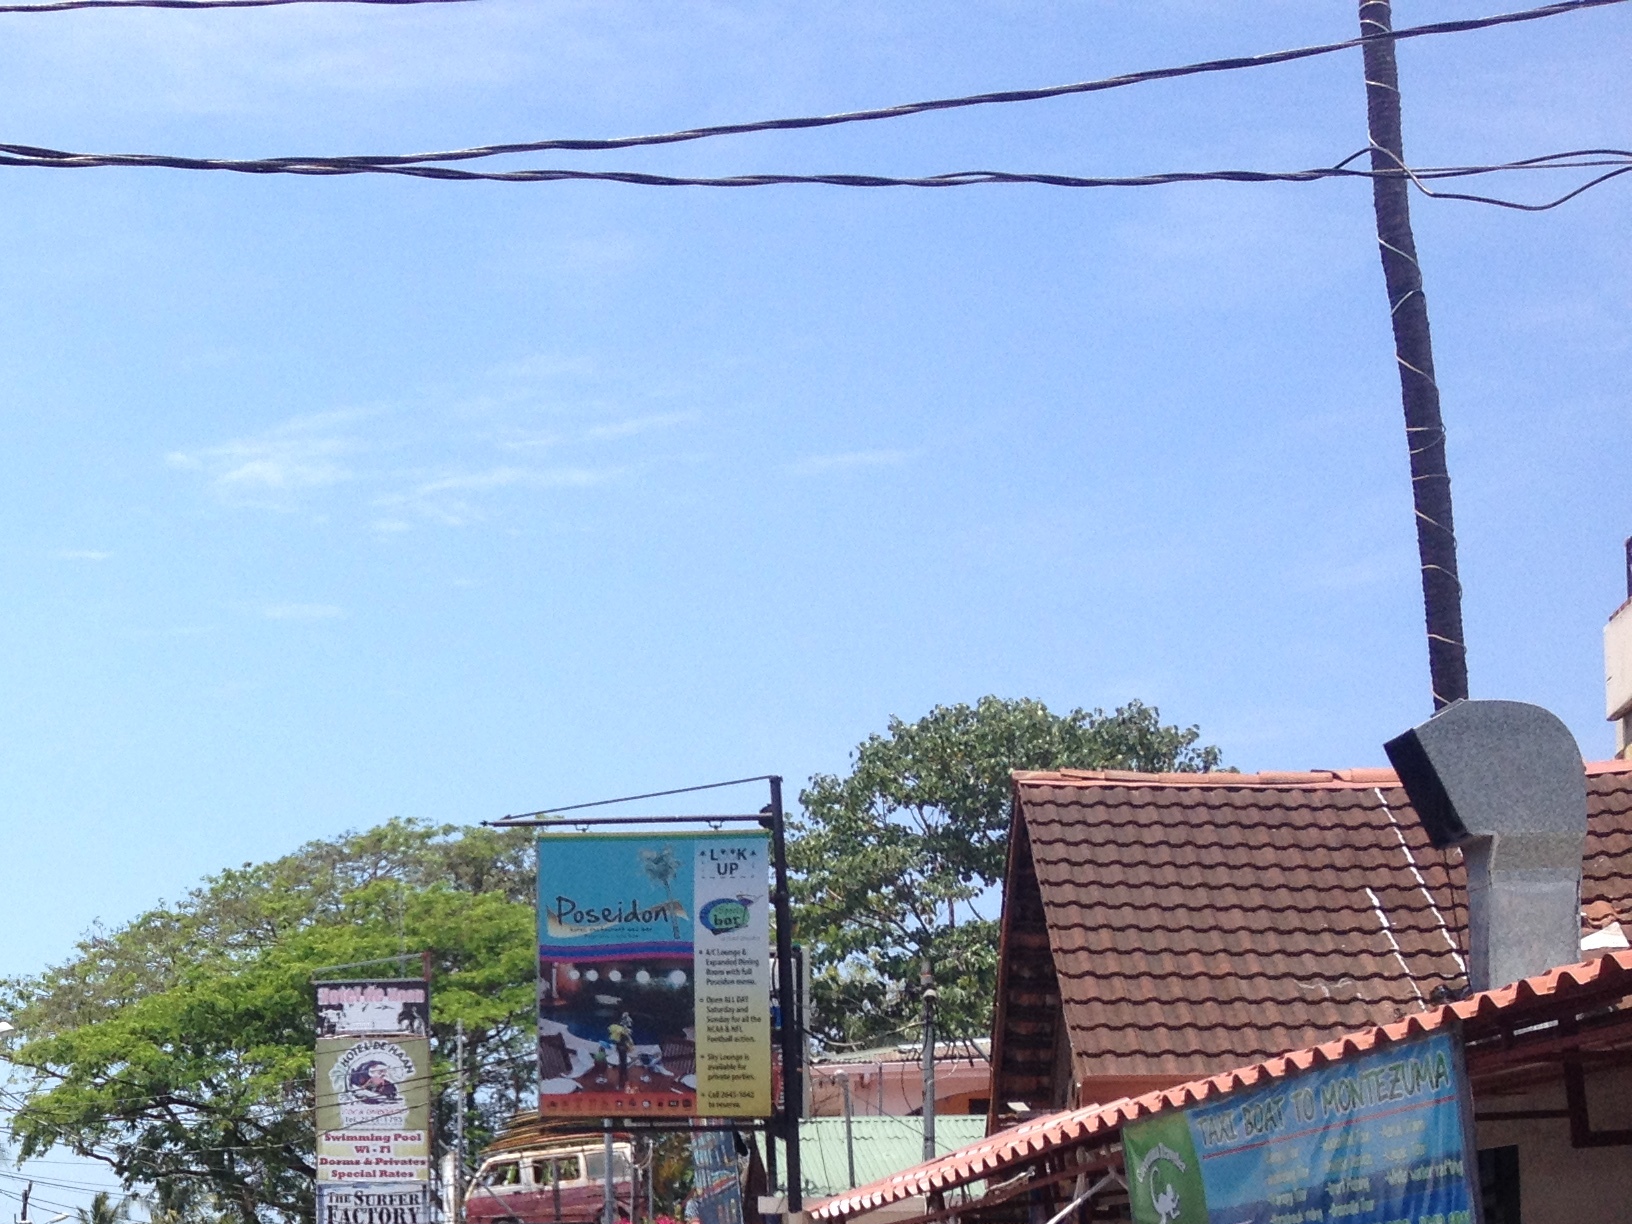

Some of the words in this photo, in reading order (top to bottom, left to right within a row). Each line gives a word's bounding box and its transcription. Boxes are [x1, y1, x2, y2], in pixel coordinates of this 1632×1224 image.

[717, 862, 739, 876] UP
[556, 896, 668, 926] Poseidon
[340, 1041, 371, 1068] HOTEL
[373, 1041, 388, 1051] DE
[1196, 1110, 1238, 1148] TAXI
[1241, 1096, 1285, 1137] BOAT
[1290, 1088, 1315, 1123] TO
[1320, 1050, 1451, 1118] MONTEZUMA
[324, 1133, 390, 1143] Swimming
[394, 1133, 422, 1142] Pool
[331, 1169, 376, 1179] Special
[379, 1169, 414, 1178] Rates
[354, 1190, 420, 1206] SURFER
[327, 1205, 420, 1224] FACTORY
